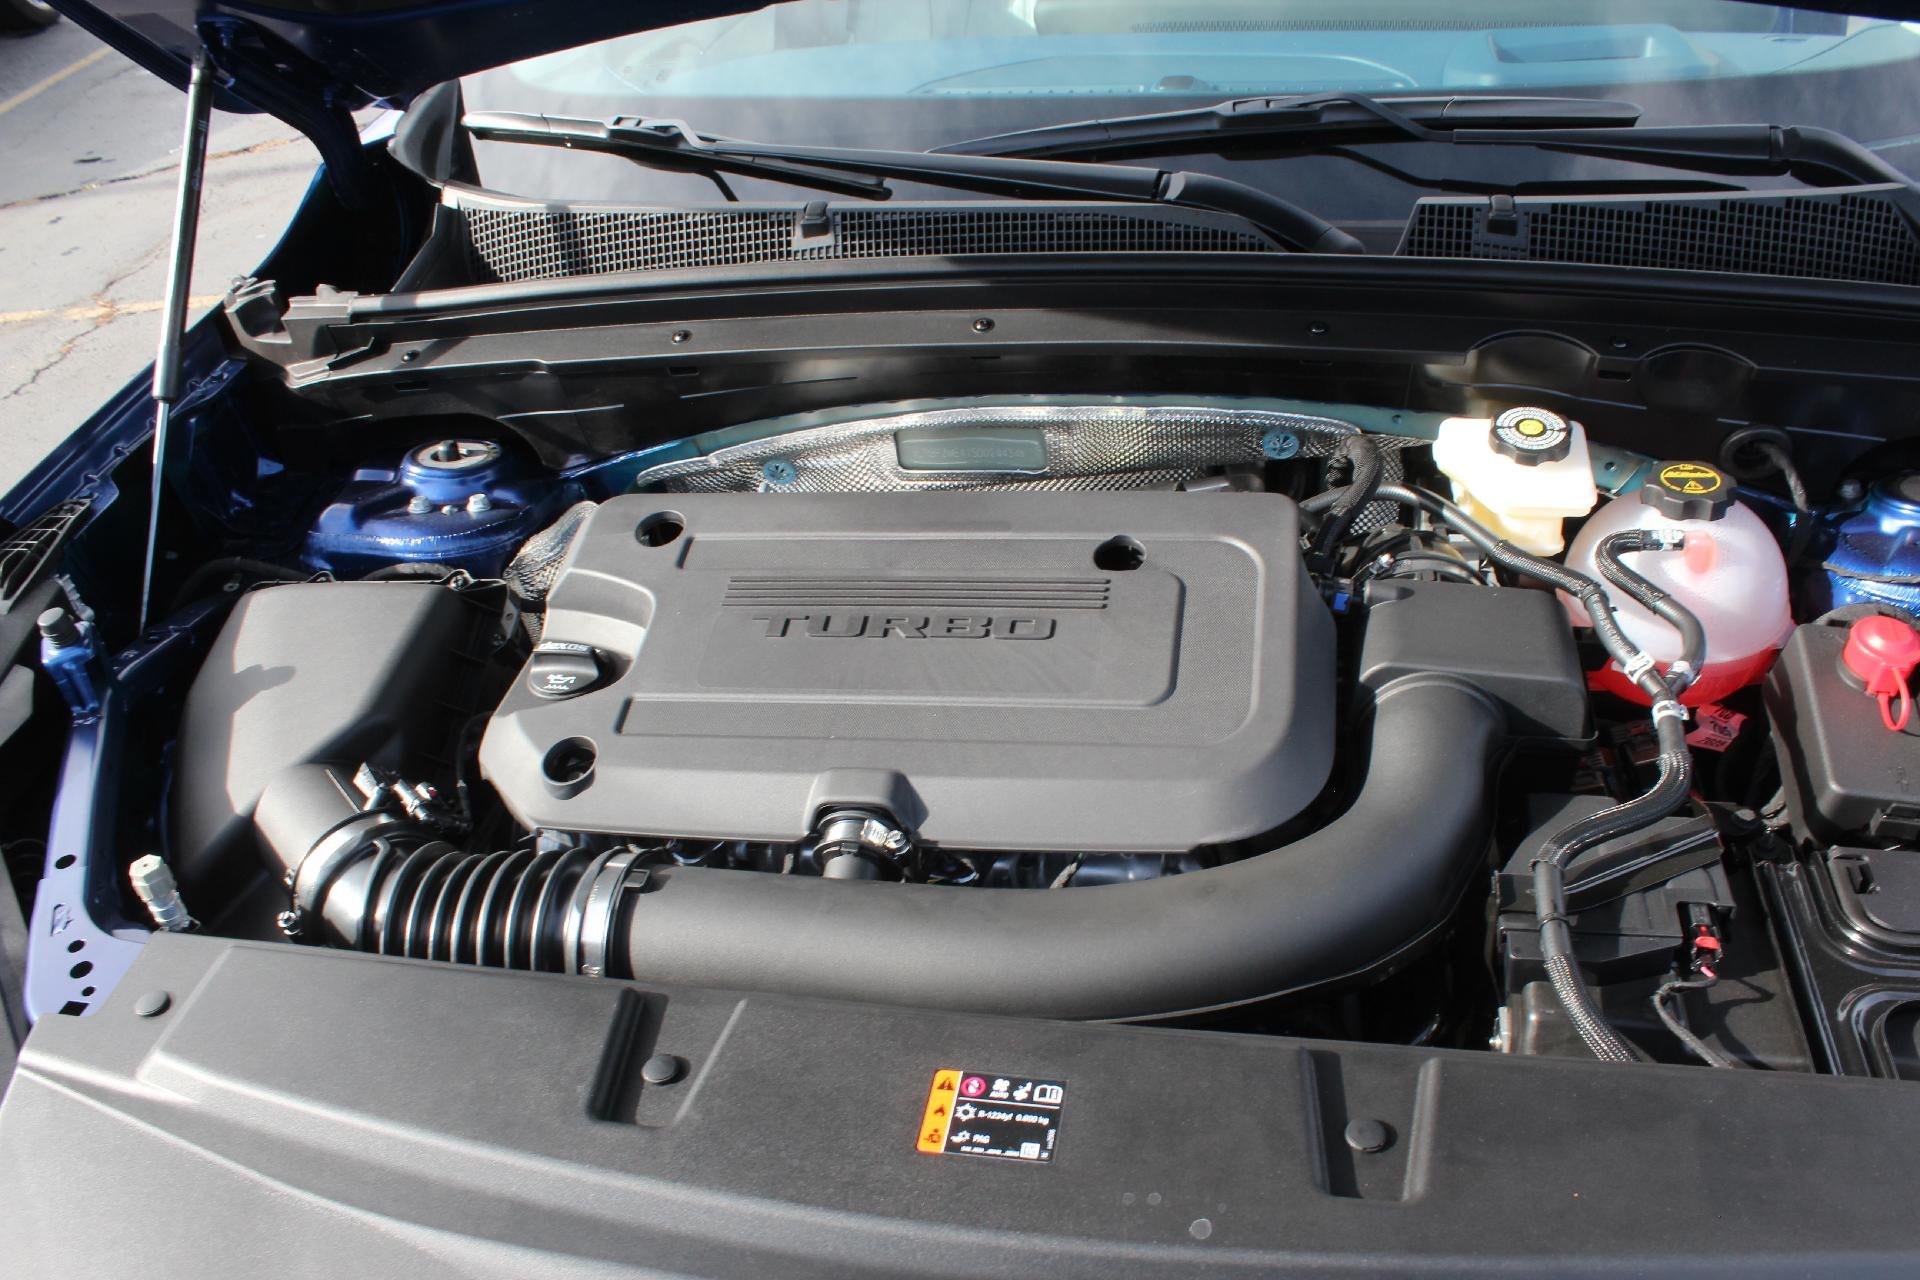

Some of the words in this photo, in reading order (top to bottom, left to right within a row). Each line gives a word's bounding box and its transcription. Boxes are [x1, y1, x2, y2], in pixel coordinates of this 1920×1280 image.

[752, 615, 1057, 640] TURBO
[538, 642, 590, 651] dexos
[972, 1134, 990, 1143] PAG
